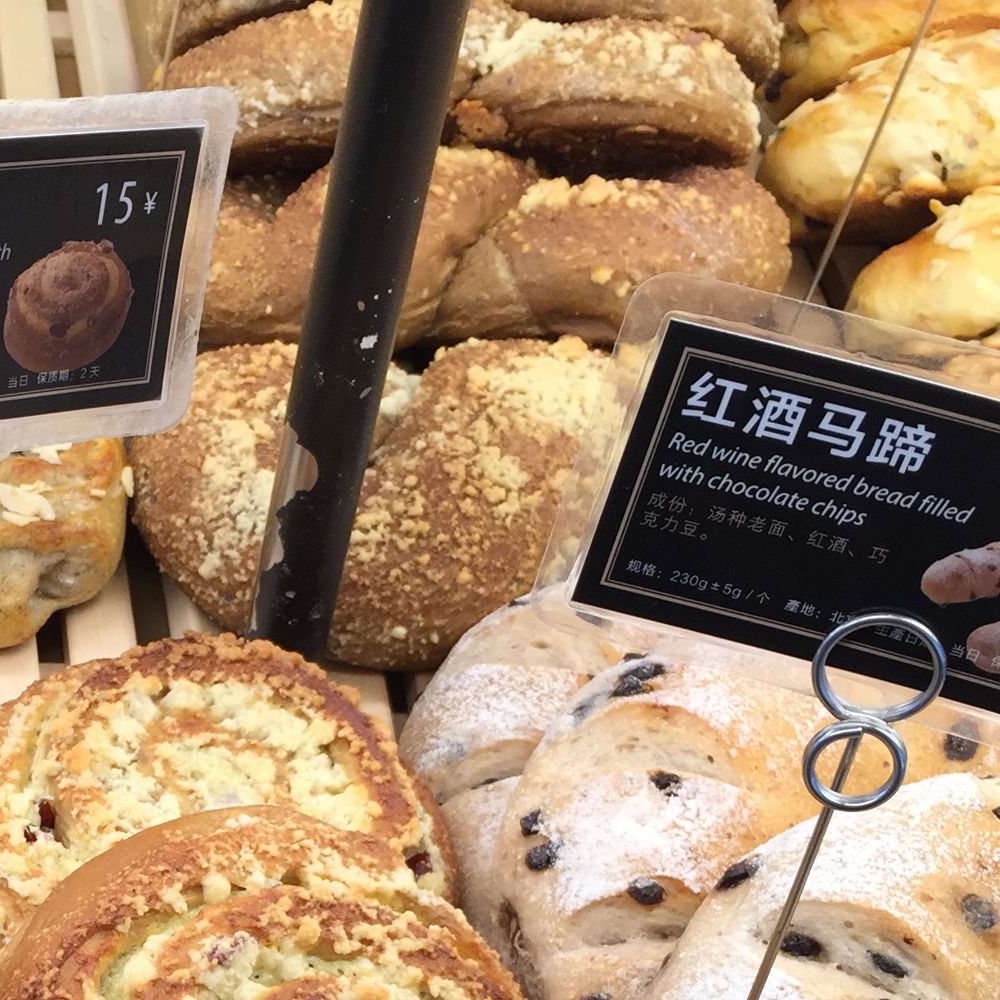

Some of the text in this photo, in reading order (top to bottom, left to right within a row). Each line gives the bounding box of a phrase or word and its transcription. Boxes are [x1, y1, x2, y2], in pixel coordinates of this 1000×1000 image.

[680, 371, 937, 475] 红酒马蹄
[658, 463, 869, 526] with chocolate chips
[667, 432, 977, 524] Red wine flavored bread filled
